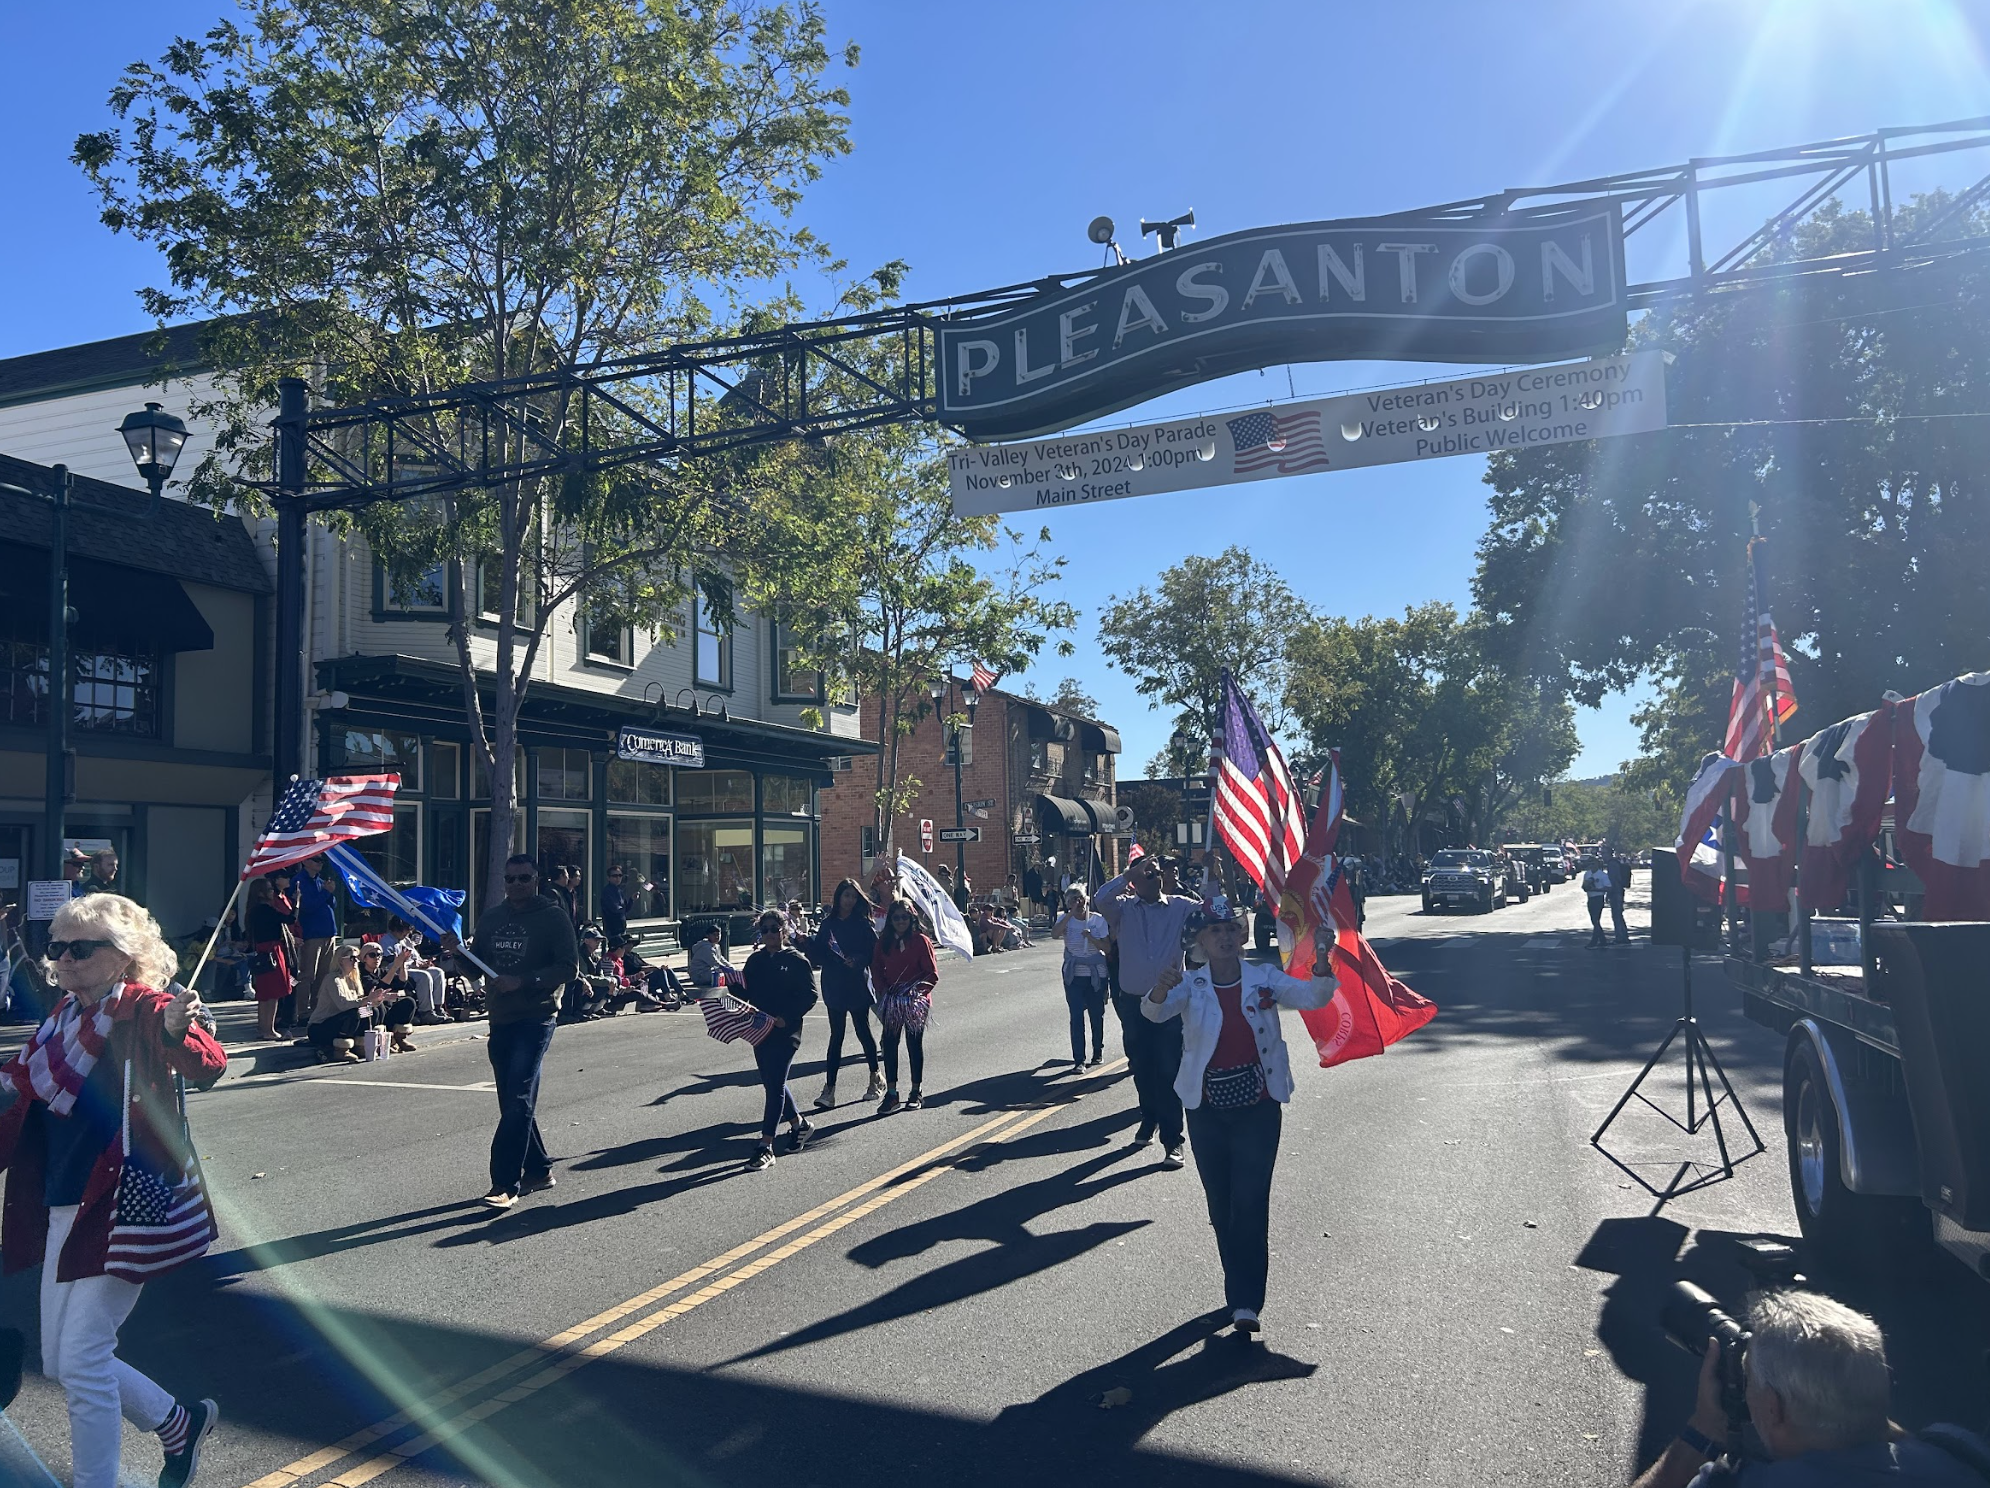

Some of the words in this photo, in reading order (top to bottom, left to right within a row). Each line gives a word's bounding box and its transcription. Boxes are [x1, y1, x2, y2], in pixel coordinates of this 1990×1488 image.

[957, 233, 1595, 397] PLEASANTON
[1367, 383, 1464, 413] Veteran's
[1470, 379, 1511, 401] Day
[1517, 363, 1632, 392] Ceremony
[1361, 411, 1457, 438] Veteran's
[1463, 398, 1552, 426] Building
[1560, 387, 1643, 414] 1:40pm
[979, 446, 1029, 467] Valley
[1034, 436, 1113, 462] Veteran's
[1116, 432, 1151, 454] Day
[1155, 421, 1217, 445] Parade
[1416, 435, 1481, 456] Public
[1486, 422, 1588, 448] Welcome
[966, 466, 1051, 491] November
[1036, 488, 1076, 506] Main
[1081, 479, 1131, 500] Street
[674, 739, 699, 757] Bank
[496, 941, 523, 949] HURLEY
